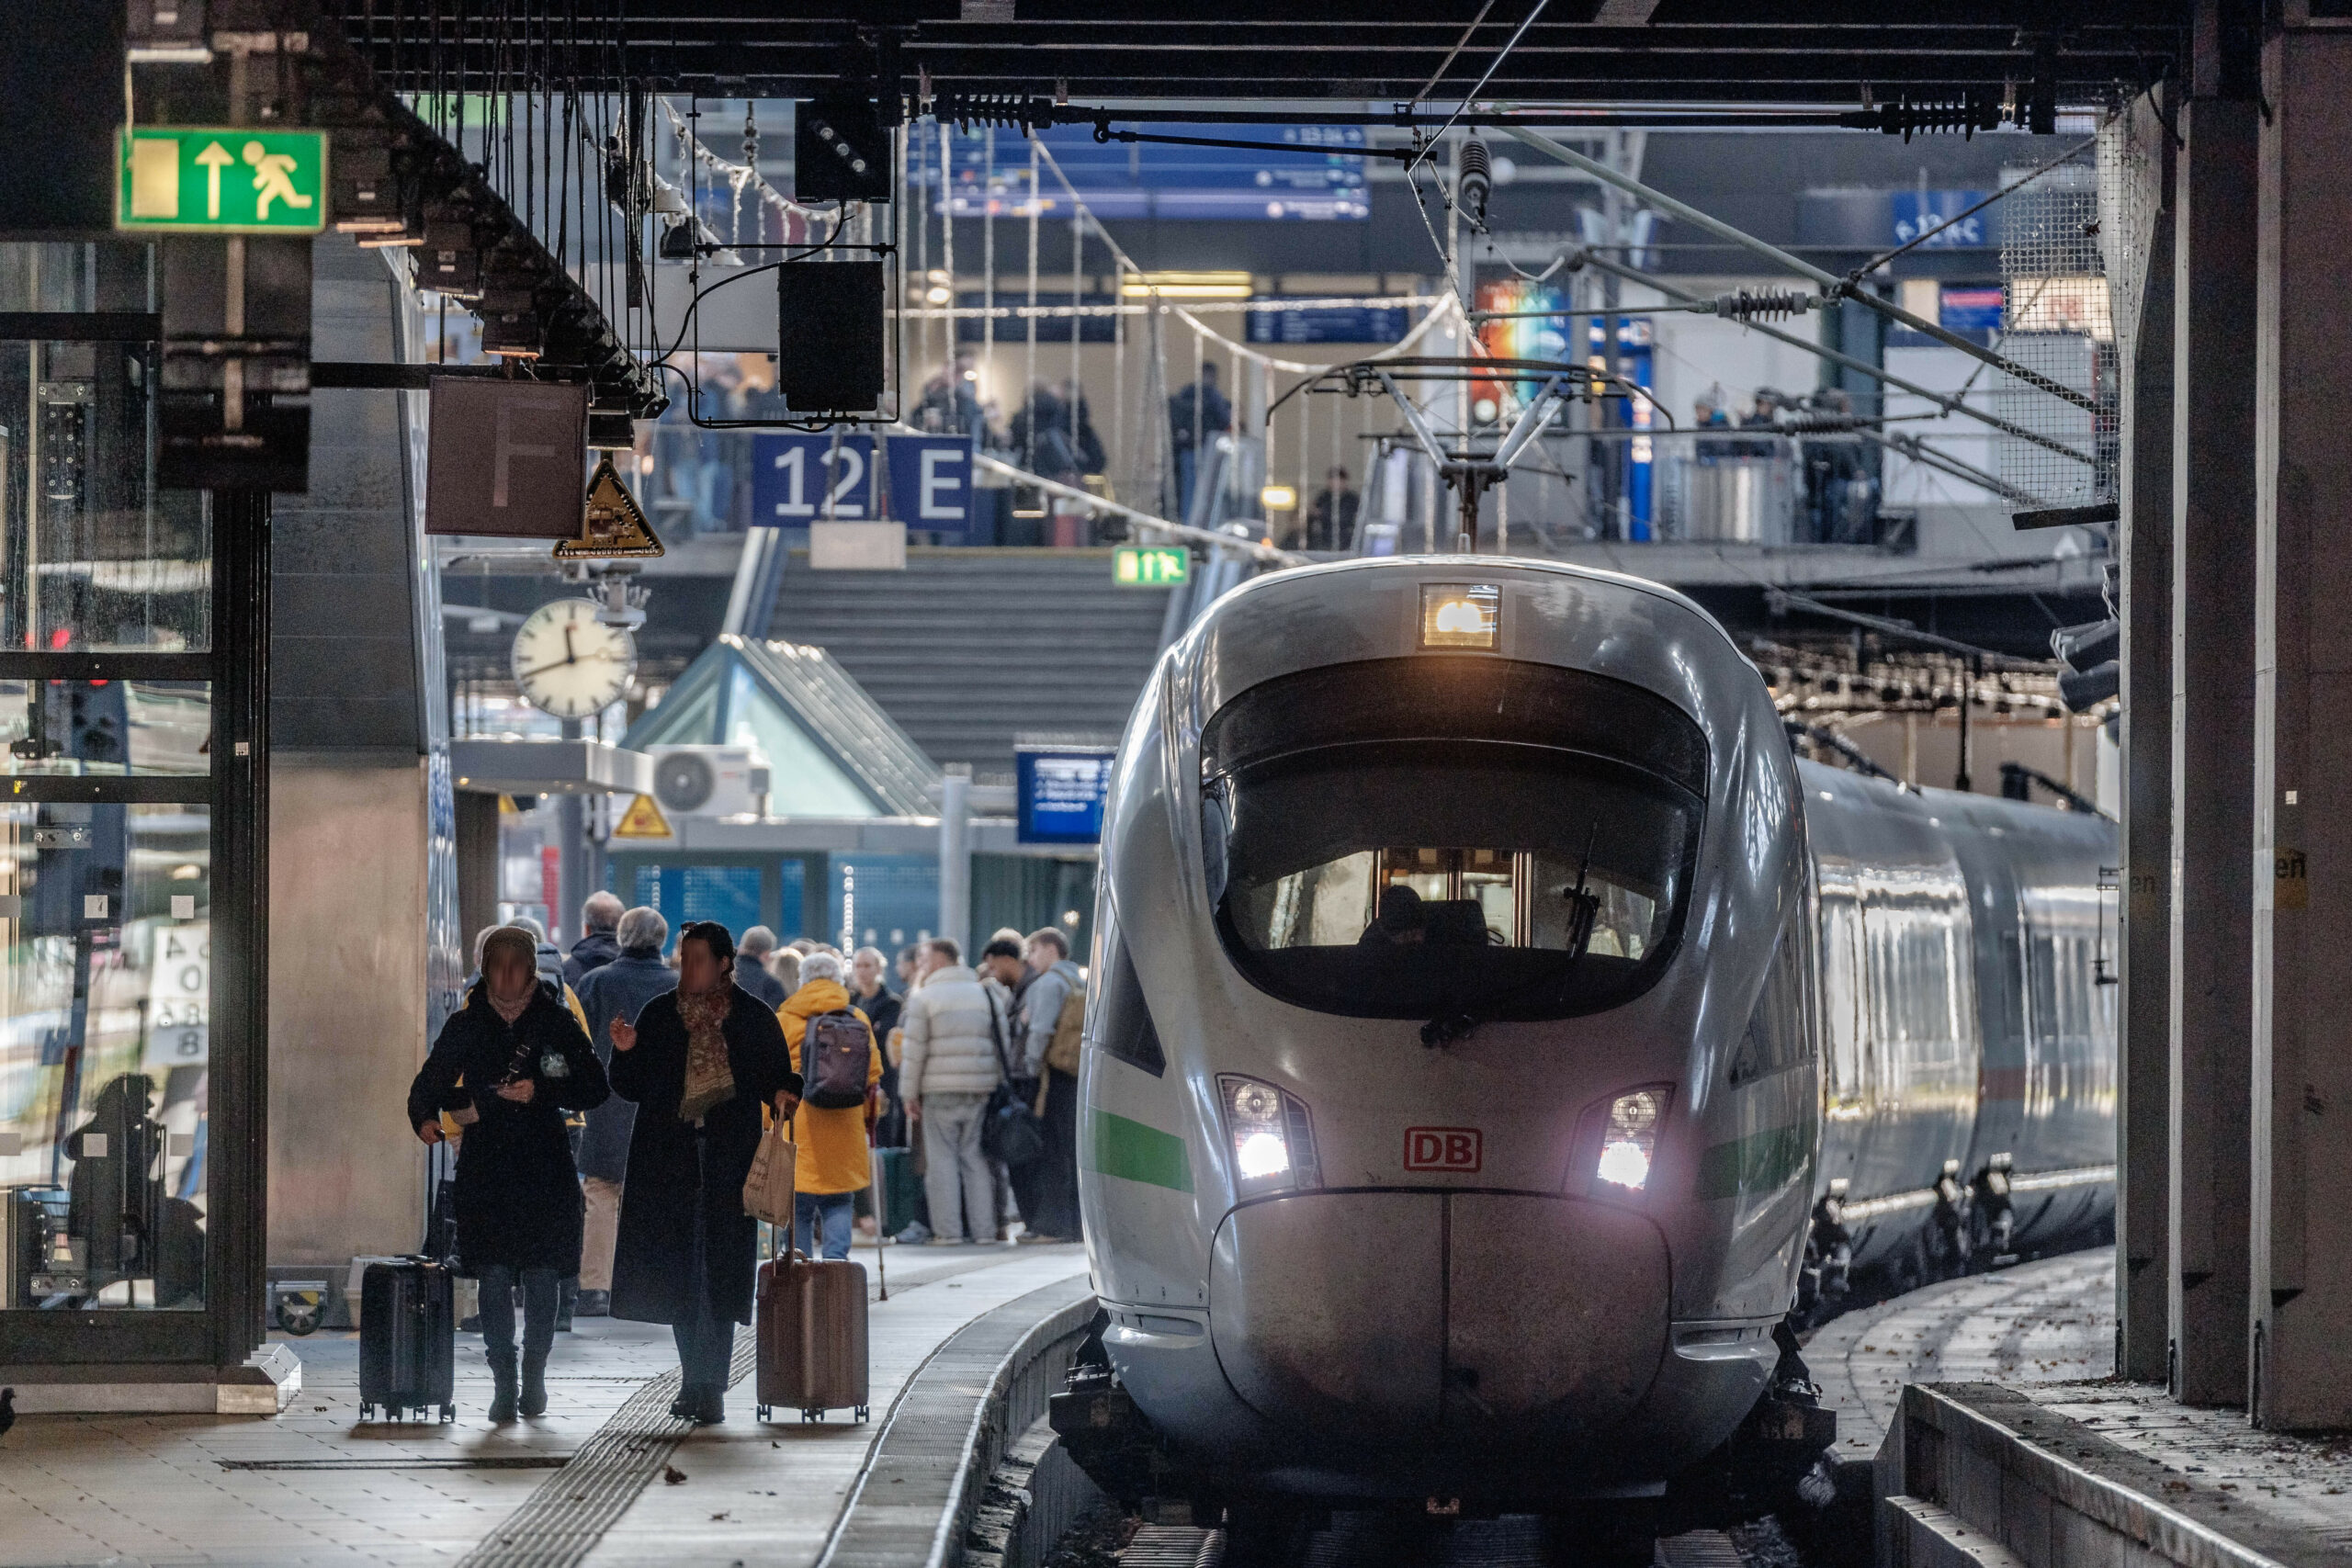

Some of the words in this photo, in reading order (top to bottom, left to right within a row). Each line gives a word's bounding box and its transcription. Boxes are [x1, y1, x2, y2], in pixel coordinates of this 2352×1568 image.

[492, 396, 560, 507] F
[775, 446, 864, 517] 12
[920, 449, 965, 519] E
[1414, 1134, 1473, 1164] DB
